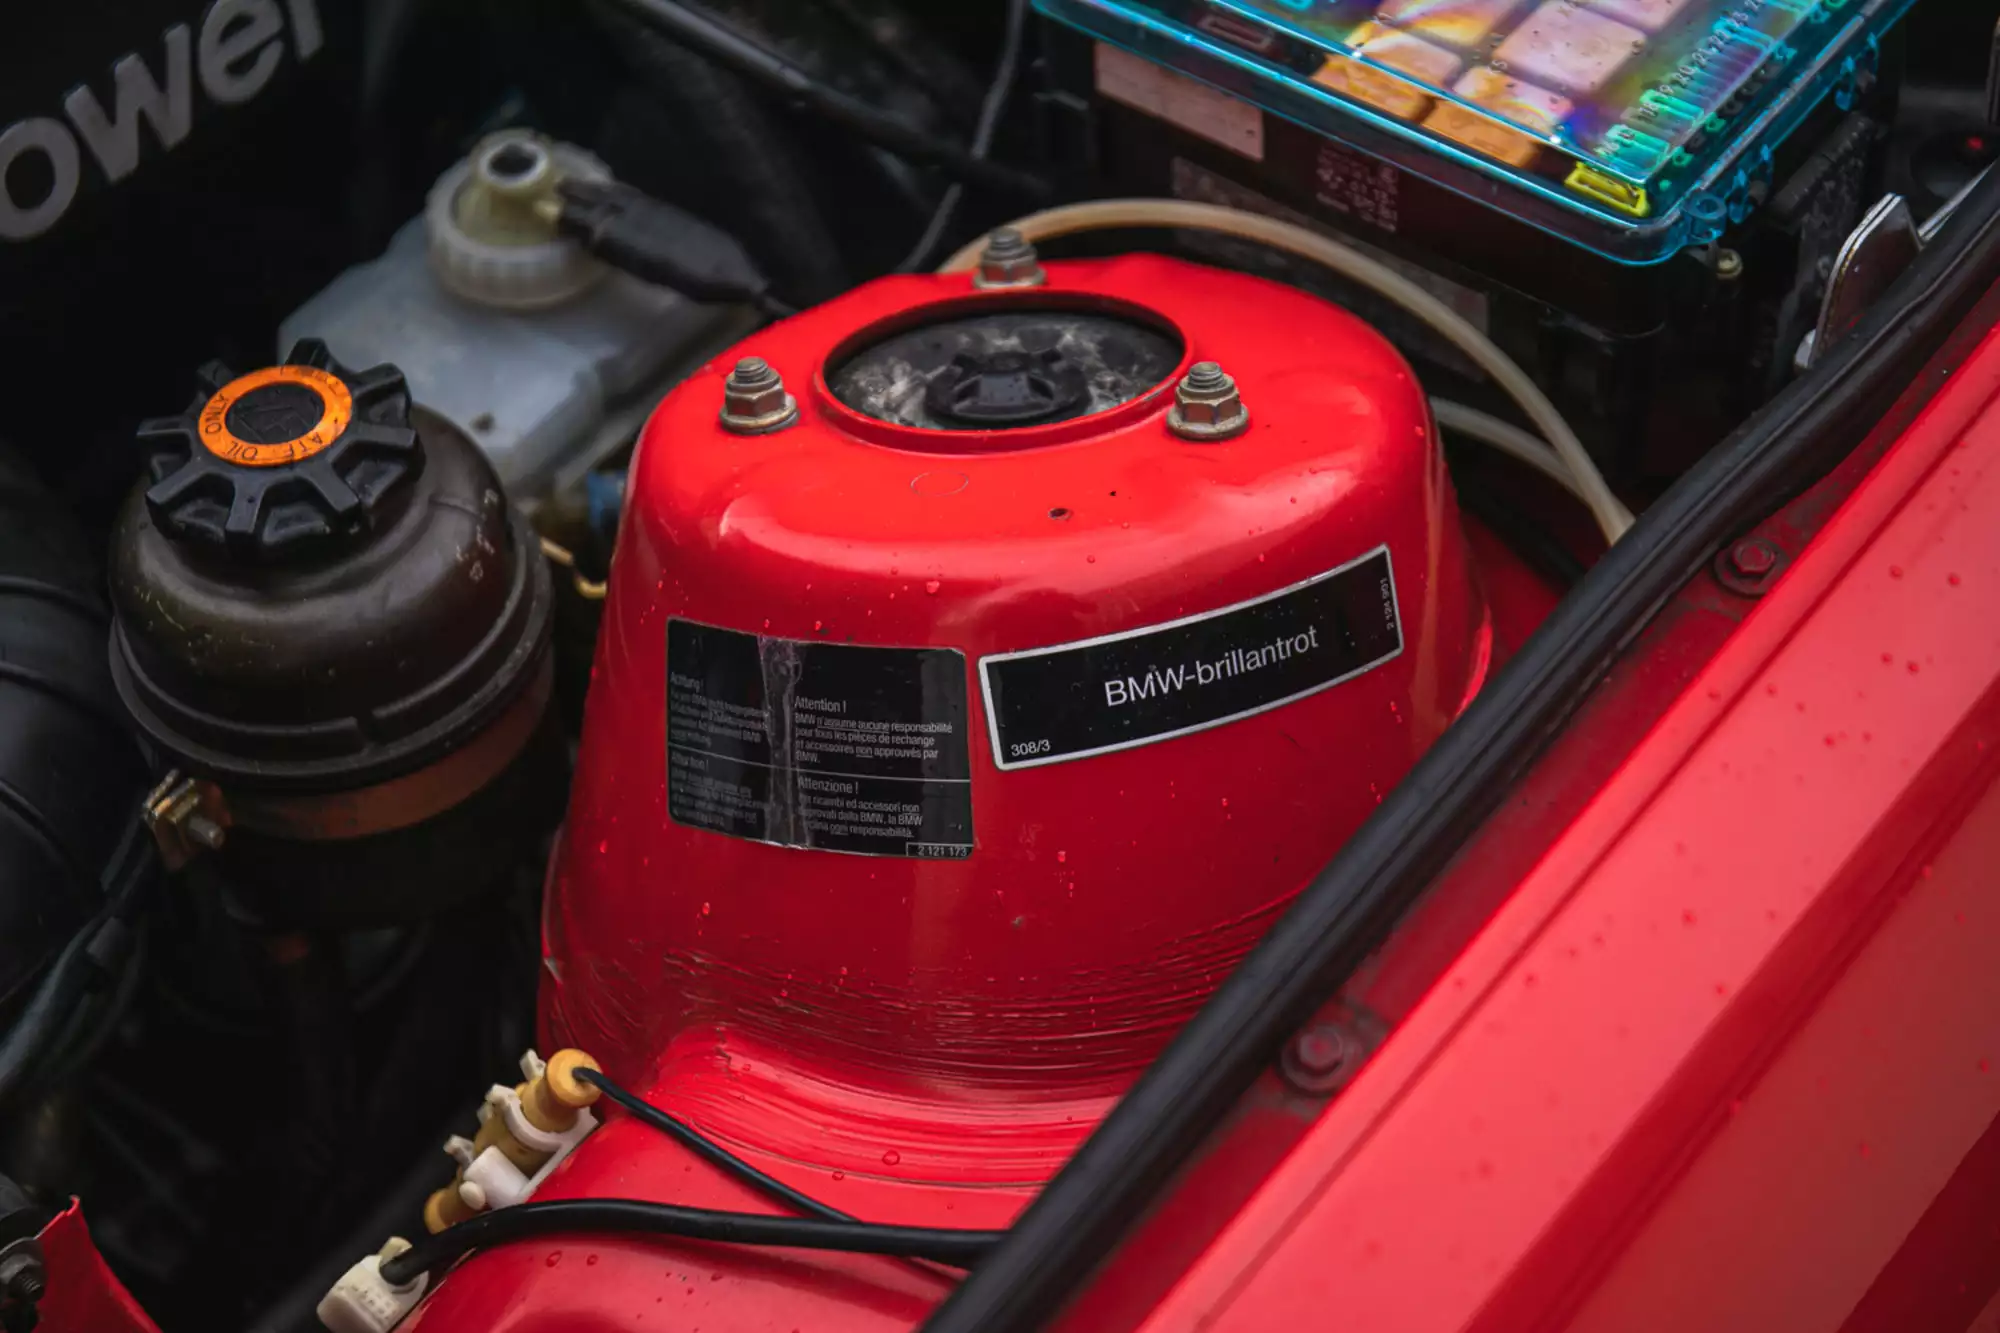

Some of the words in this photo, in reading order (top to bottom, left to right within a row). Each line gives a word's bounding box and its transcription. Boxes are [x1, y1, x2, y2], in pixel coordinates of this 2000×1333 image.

[204, 393, 229, 436] ONLY
[226, 440, 258, 461] OIL
[1104, 625, 1318, 707] BMW-brillantrot
[891, 720, 953, 734] responsabilité
[879, 732, 890, 744] de
[891, 734, 935, 748] rechange
[1010, 739, 1051, 757] 308/3
[923, 748, 939, 760] par
[898, 813, 923, 826] BMW
[918, 846, 925, 856] 2
